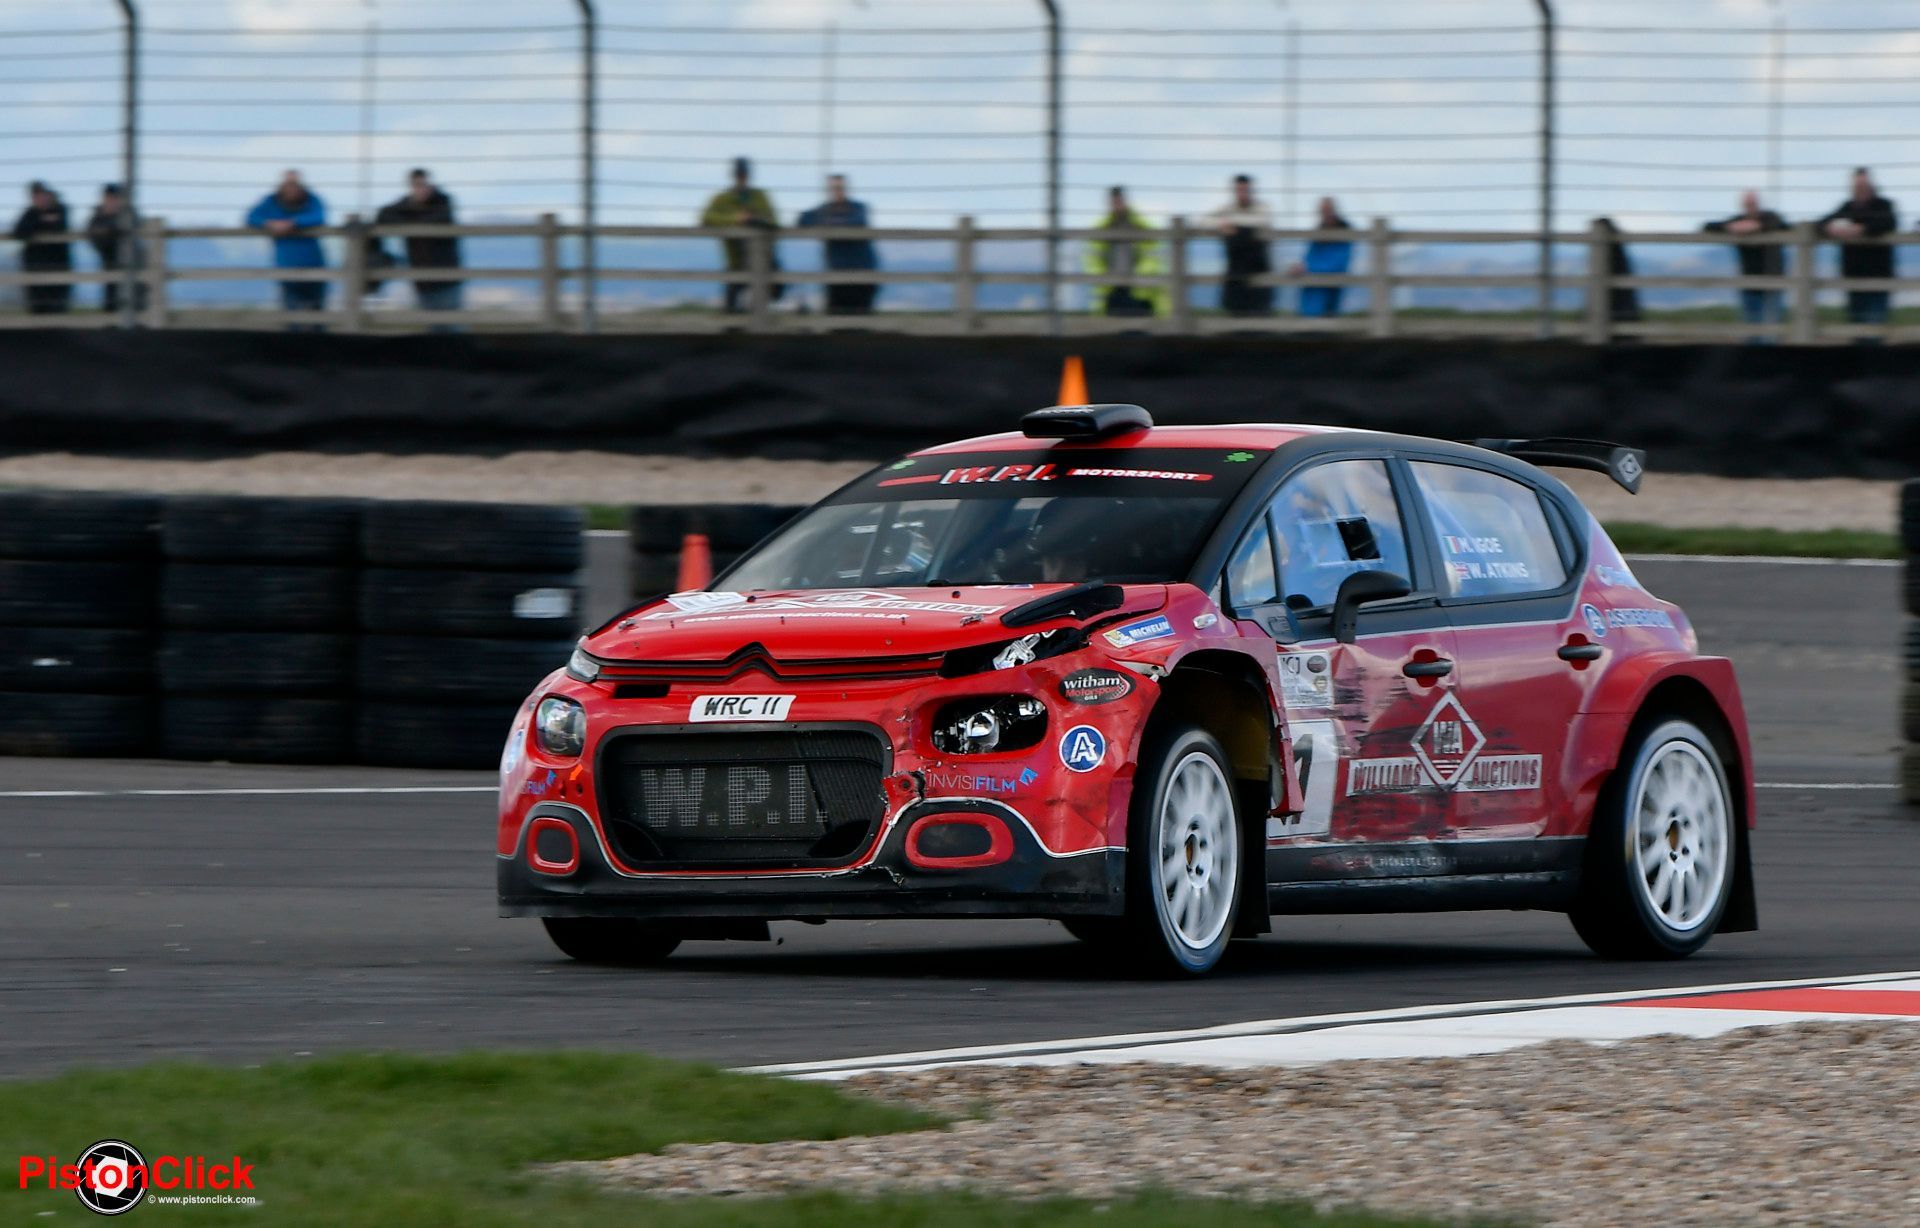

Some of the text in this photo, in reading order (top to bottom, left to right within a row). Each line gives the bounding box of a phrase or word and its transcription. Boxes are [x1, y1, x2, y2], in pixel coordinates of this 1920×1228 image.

[939, 463, 1198, 485] W.P.I. MOTORSPORT
[1486, 562, 1529, 578] ATKINS
[1129, 621, 1170, 638] MICHELIN
[1063, 675, 1120, 690] witham
[703, 697, 758, 716] WRC
[928, 773, 1016, 793] INVISIFILM
[1353, 759, 1539, 791] WILLIAMS AUCTIONS
[640, 765, 828, 827] W.P.I.
